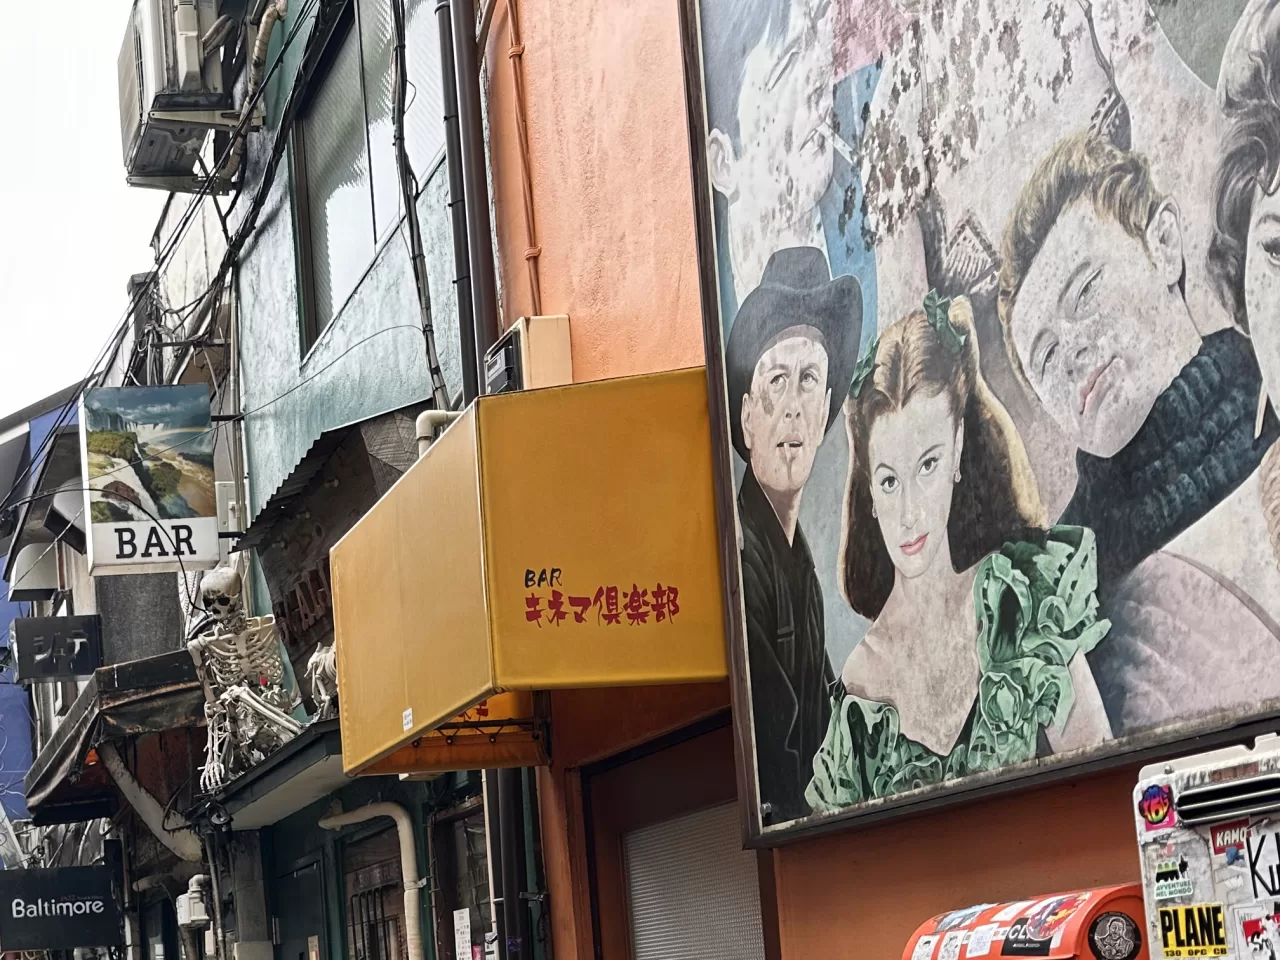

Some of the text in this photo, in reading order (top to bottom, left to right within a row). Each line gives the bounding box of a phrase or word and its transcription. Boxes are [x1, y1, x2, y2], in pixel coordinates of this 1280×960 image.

[114, 524, 197, 560] BAR
[524, 568, 563, 588] BAR
[12, 898, 105, 918] Baltimore
[1159, 905, 1226, 948] PLANE
